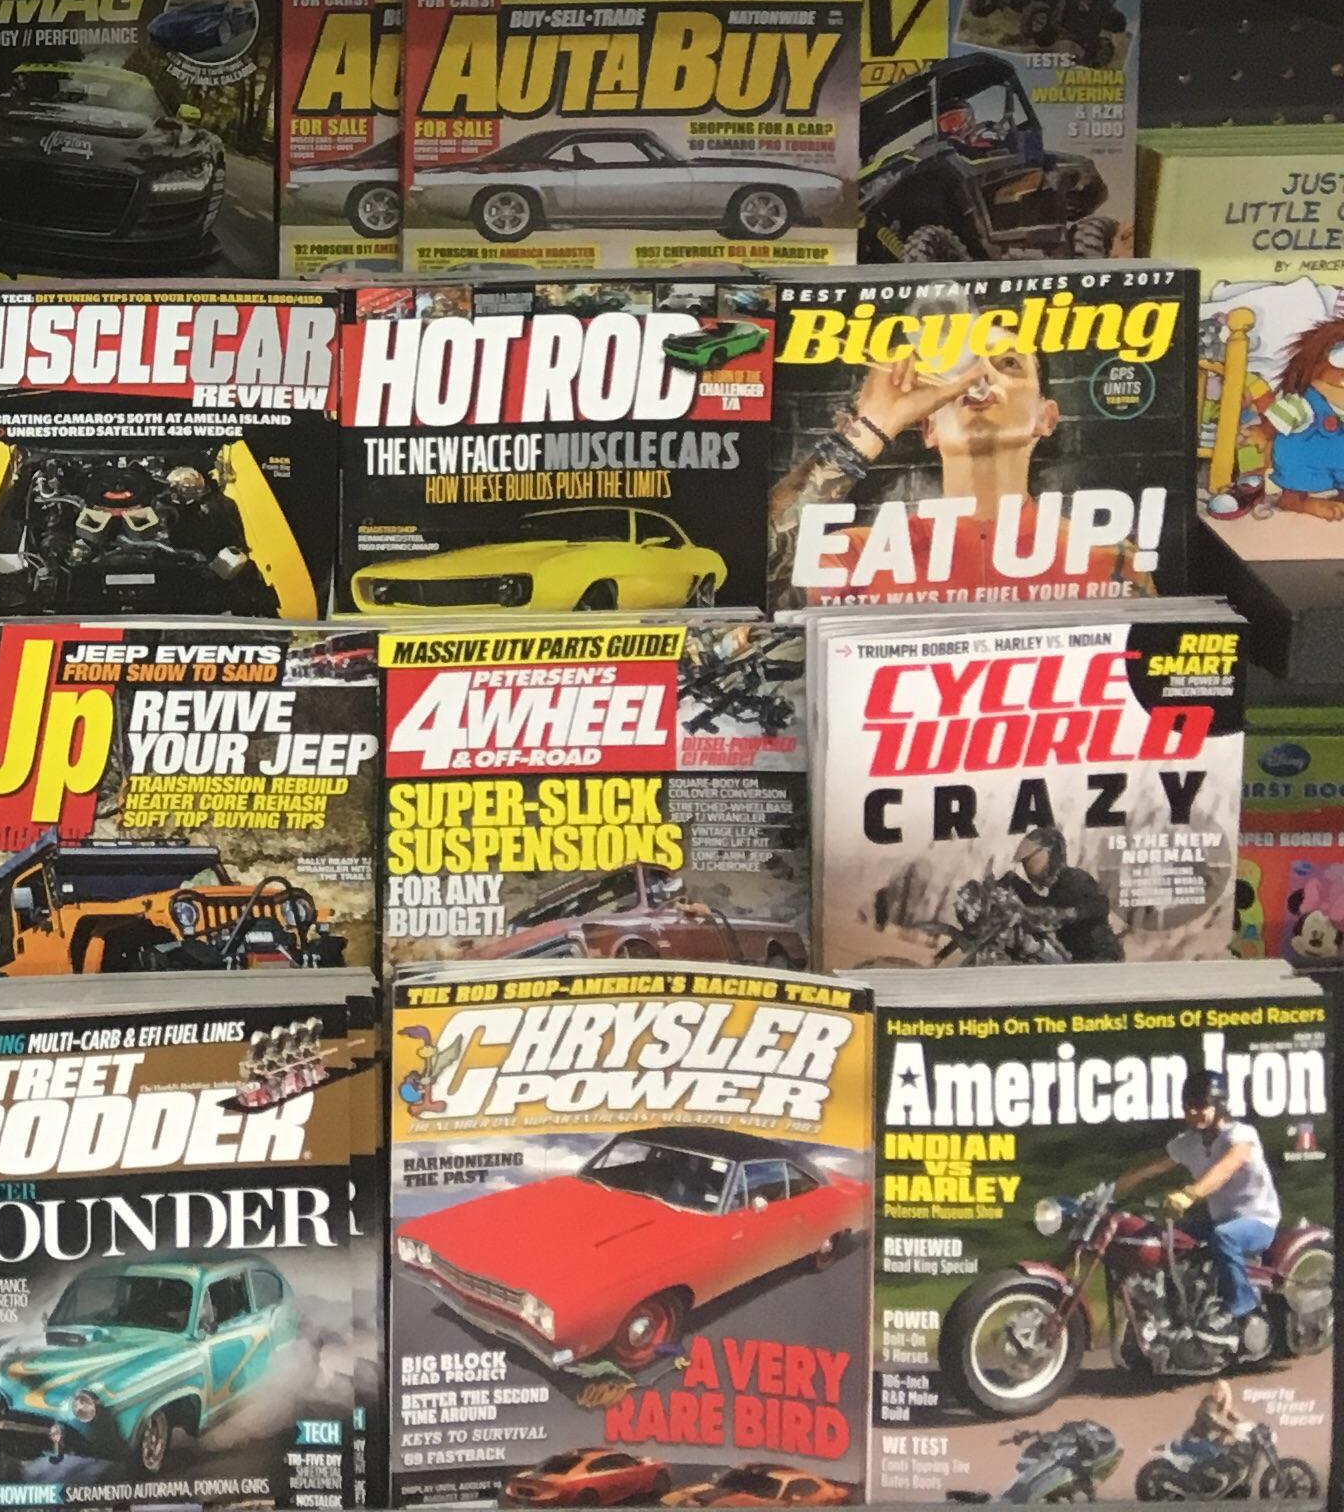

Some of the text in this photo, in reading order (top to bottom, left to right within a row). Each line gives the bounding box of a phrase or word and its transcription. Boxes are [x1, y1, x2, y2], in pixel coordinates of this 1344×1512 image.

[775, 292, 1180, 373] Bicycling
[793, 489, 1167, 590] EAT UP!
[65, 646, 281, 664] JEEP EVENTS
[1147, 655, 1238, 677] SMART
[1180, 634, 1238, 655] RIDE
[863, 650, 1142, 721] CYCLE
[129, 691, 295, 734] REVIVE
[128, 734, 377, 776] YOUR JEEP
[861, 706, 1213, 777] WORLD
[863, 771, 1208, 844] CRAZY
[387, 823, 683, 874] SUSPENSIONS
[885, 1134, 1015, 1160] INDIAN
[885, 1176, 1020, 1203] HARLEY
[884, 1239, 962, 1258] REVIEWED
[683, 1337, 851, 1403] A VERY
[304, 1421, 340, 1443] TECH
[606, 1392, 849, 1459] RARE BIRD
